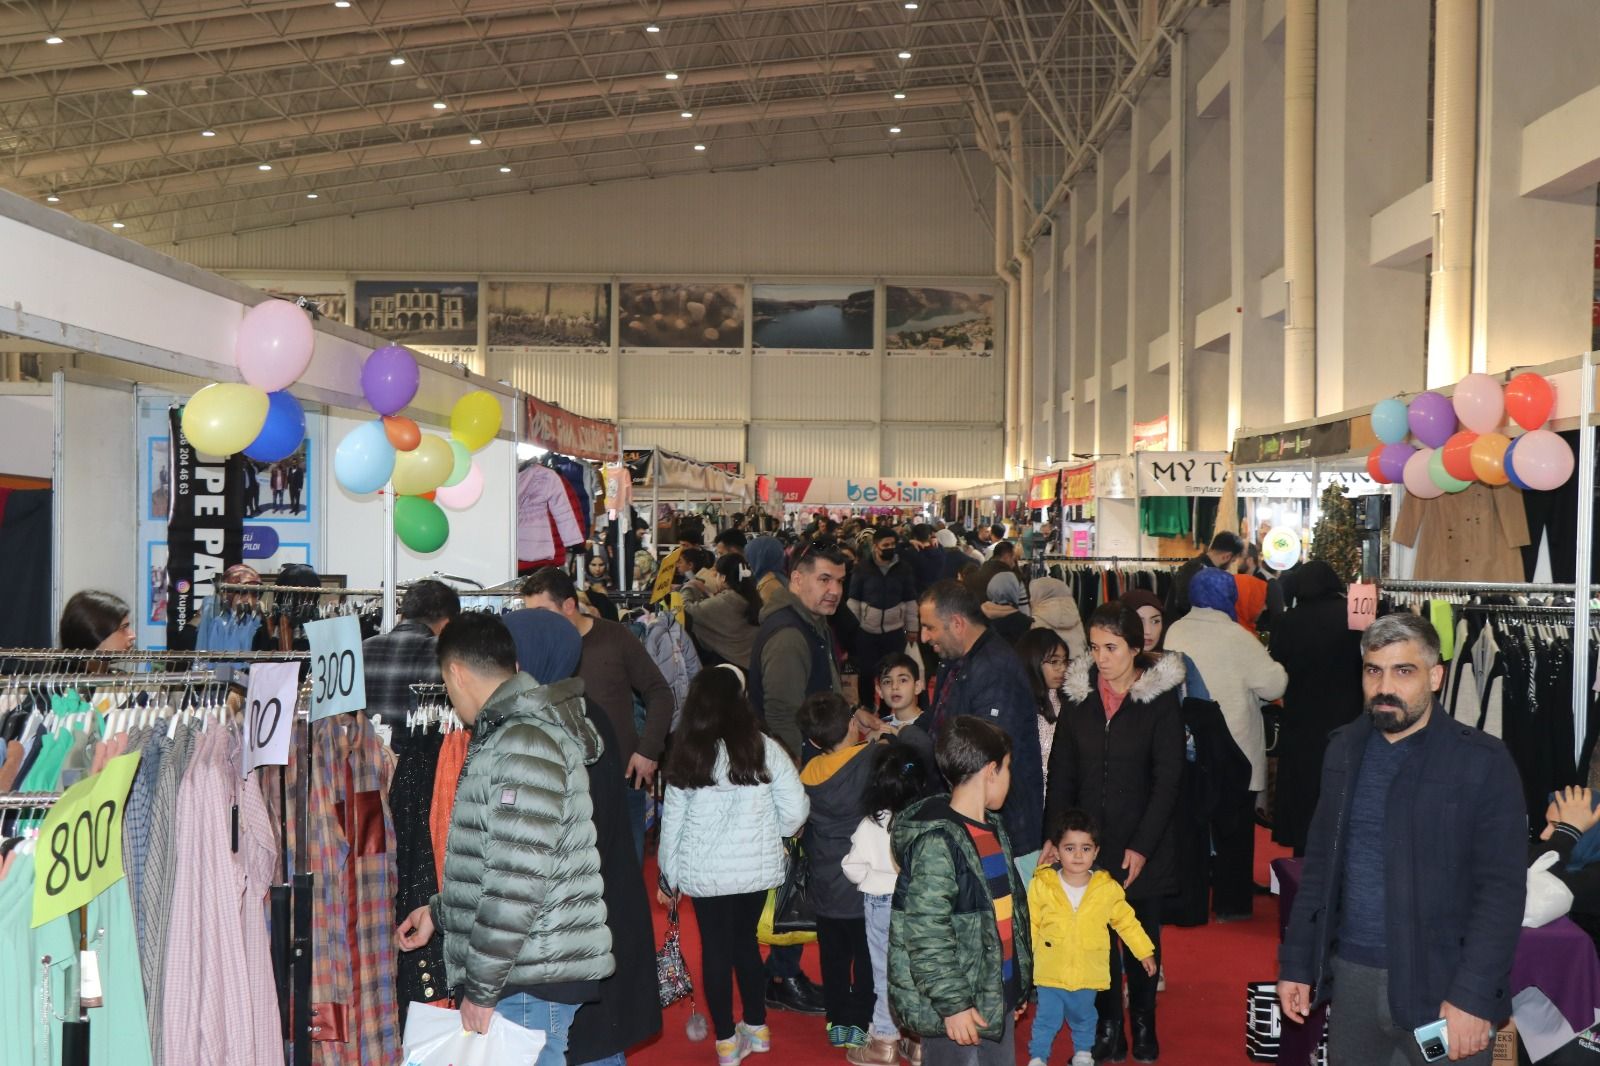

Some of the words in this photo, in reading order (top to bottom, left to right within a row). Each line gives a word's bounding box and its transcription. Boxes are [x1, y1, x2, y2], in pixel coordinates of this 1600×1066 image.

[179, 448, 189, 466] 204
[179, 468, 189, 480] 46
[1152, 459, 1196, 483] MY
[1203, 462, 1282, 483] TRZ
[179, 482, 189, 495] 63
[783, 491, 799, 501] ASI
[316, 649, 355, 704] 300
[45, 799, 116, 897] 800
[1497, 1034, 1513, 1043] EKS
